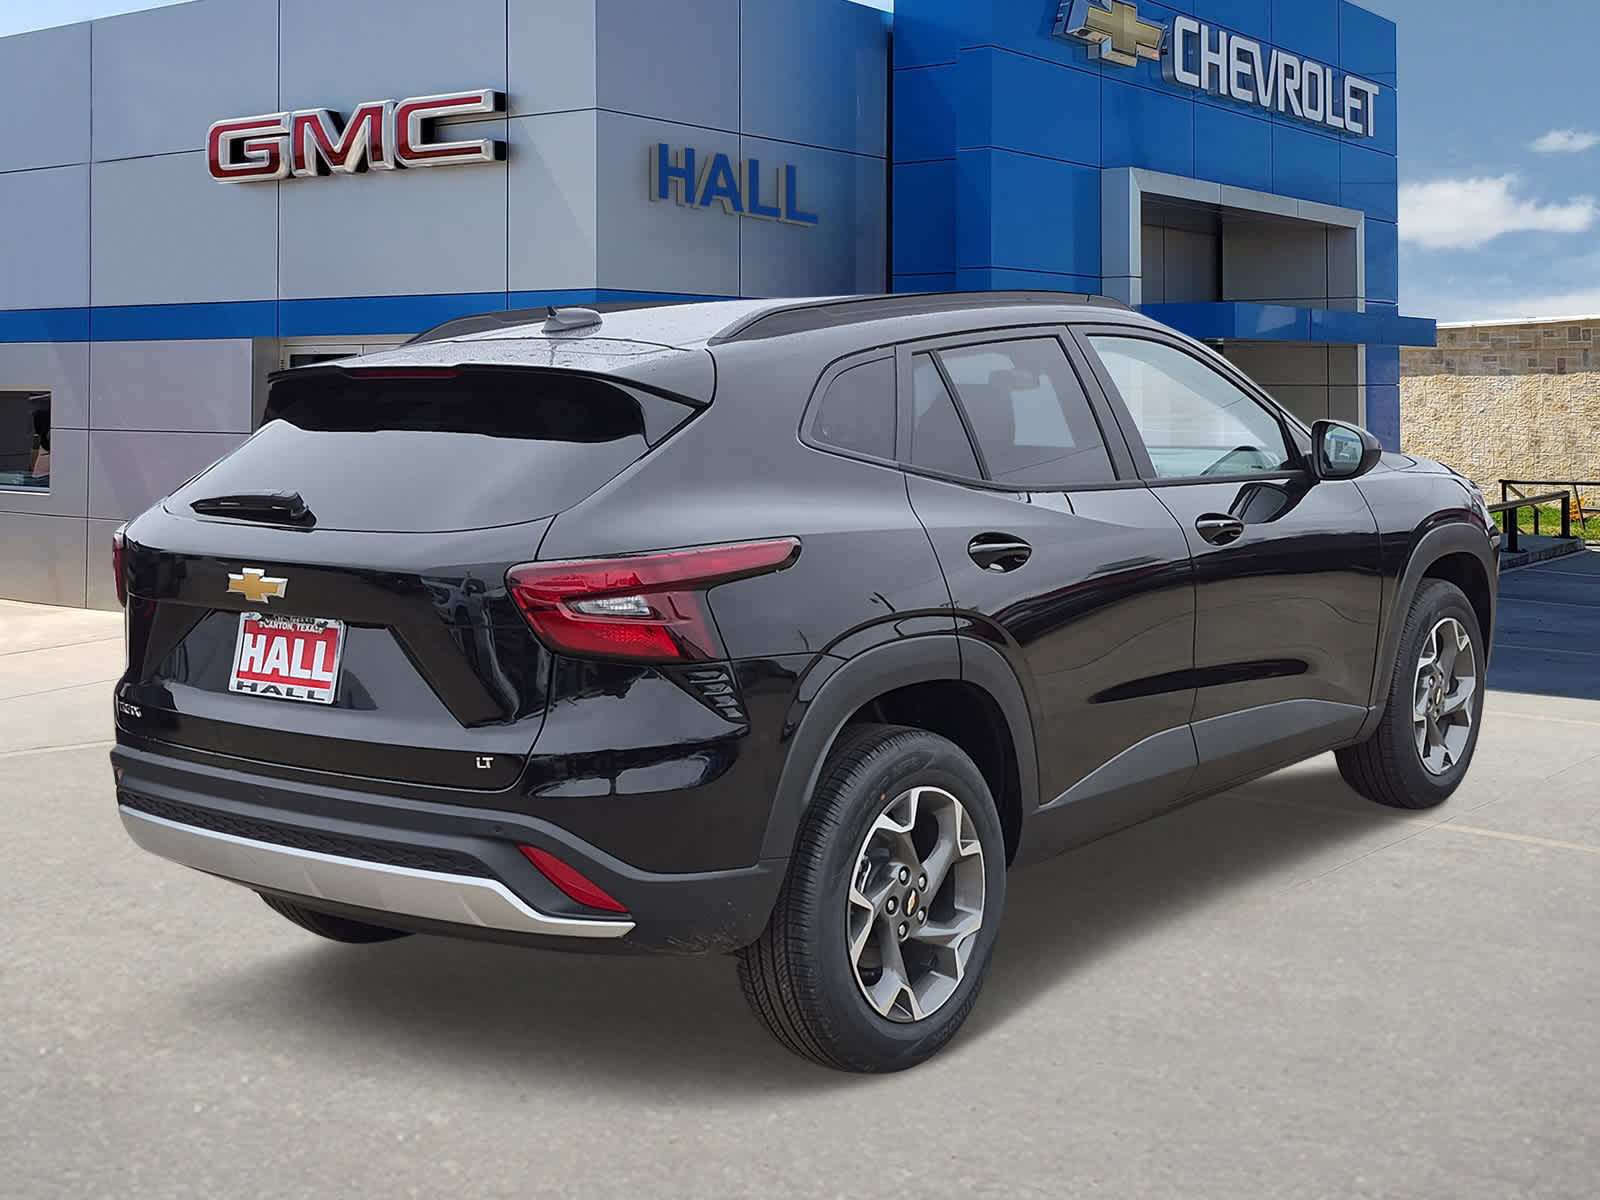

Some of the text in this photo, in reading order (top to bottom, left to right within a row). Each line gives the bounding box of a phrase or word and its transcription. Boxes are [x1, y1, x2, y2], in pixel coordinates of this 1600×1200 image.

[1173, 15, 1380, 137] CHEVROLET
[207, 88, 505, 184] GMC
[653, 143, 819, 225] HALL
[296, 623, 323, 634] TEXA
[240, 633, 333, 682] HALL
[236, 681, 325, 701] HALL
[476, 757, 494, 768] LT
